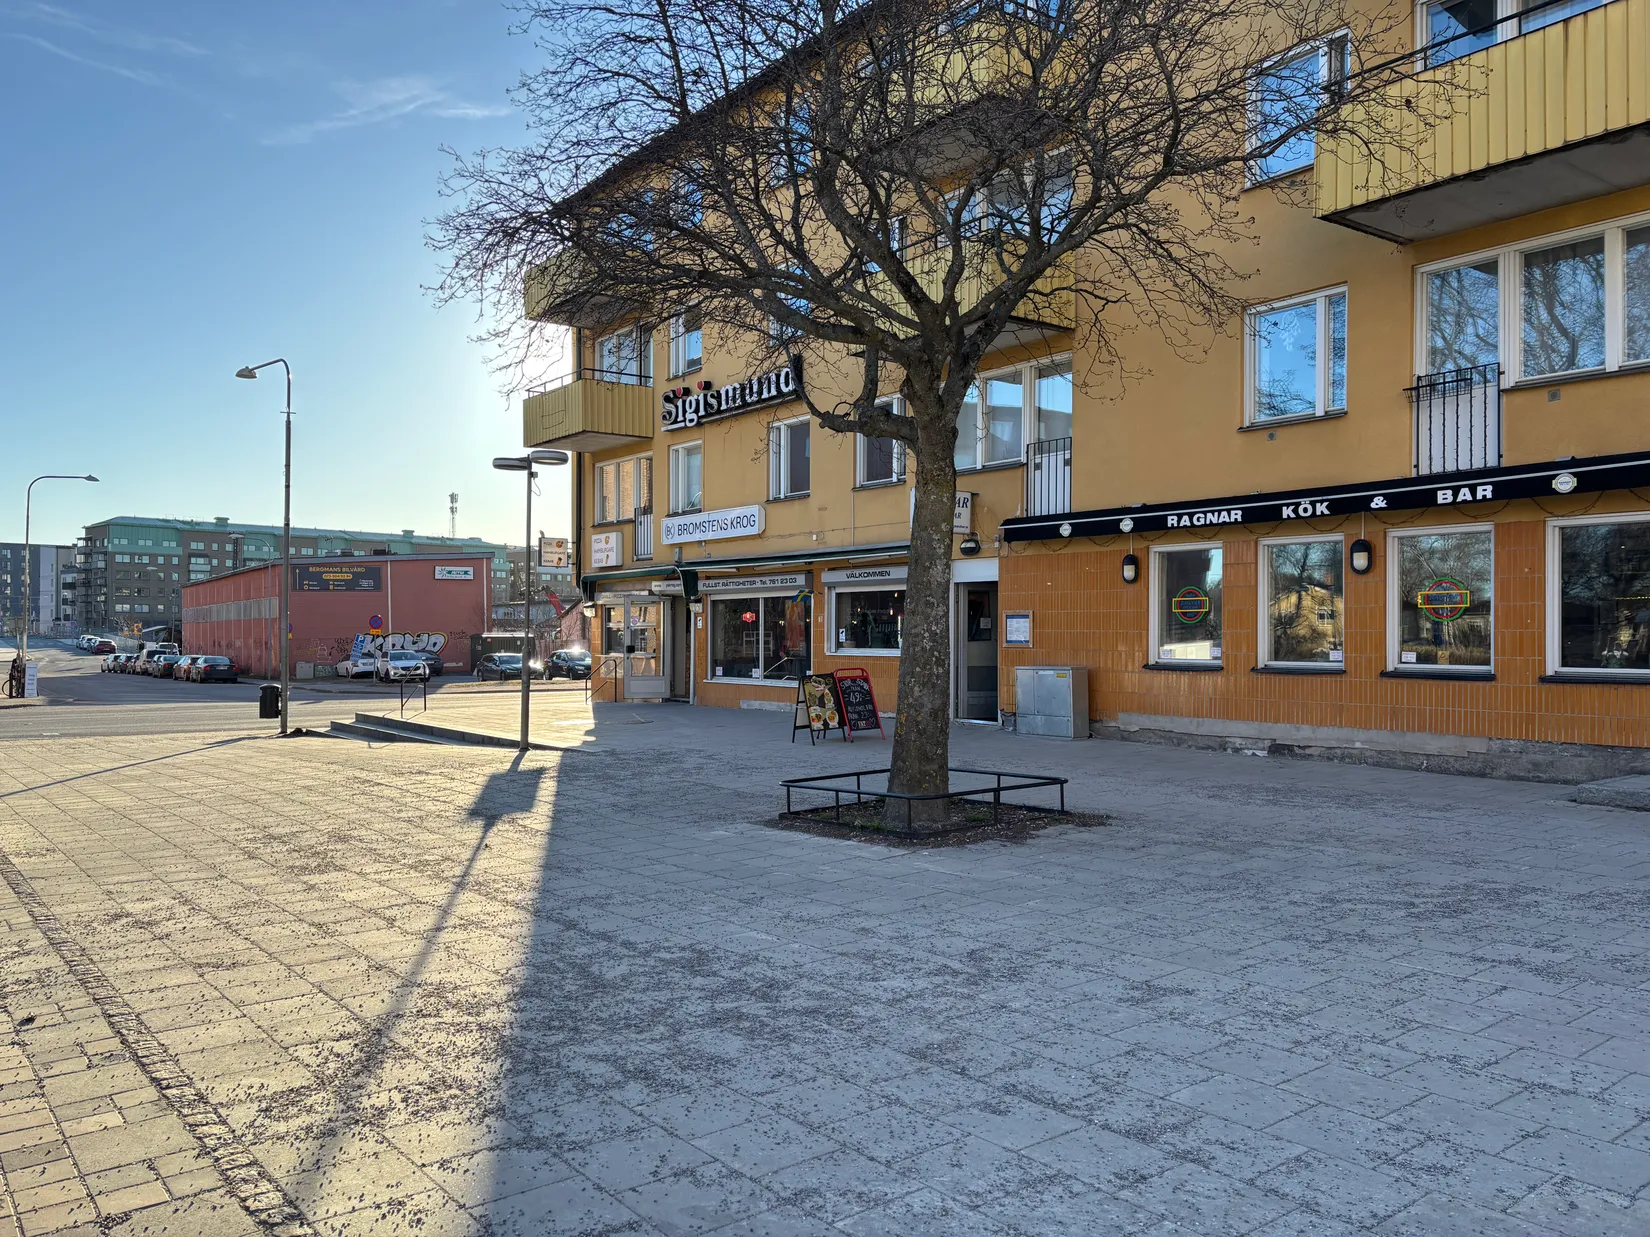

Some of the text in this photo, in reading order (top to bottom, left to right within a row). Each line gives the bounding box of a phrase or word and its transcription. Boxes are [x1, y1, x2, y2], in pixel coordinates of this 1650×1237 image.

[661, 365, 797, 427] Sigismund
[956, 496, 969, 508] AR
[1167, 485, 1493, 528] RAGNAR KÖK & BAR
[677, 518, 728, 536] BROMSTENS
[730, 514, 756, 530] KROG
[846, 570, 890, 579] VÄLKOMMEN
[722, 580, 756, 588] RÄTTIGHETER
